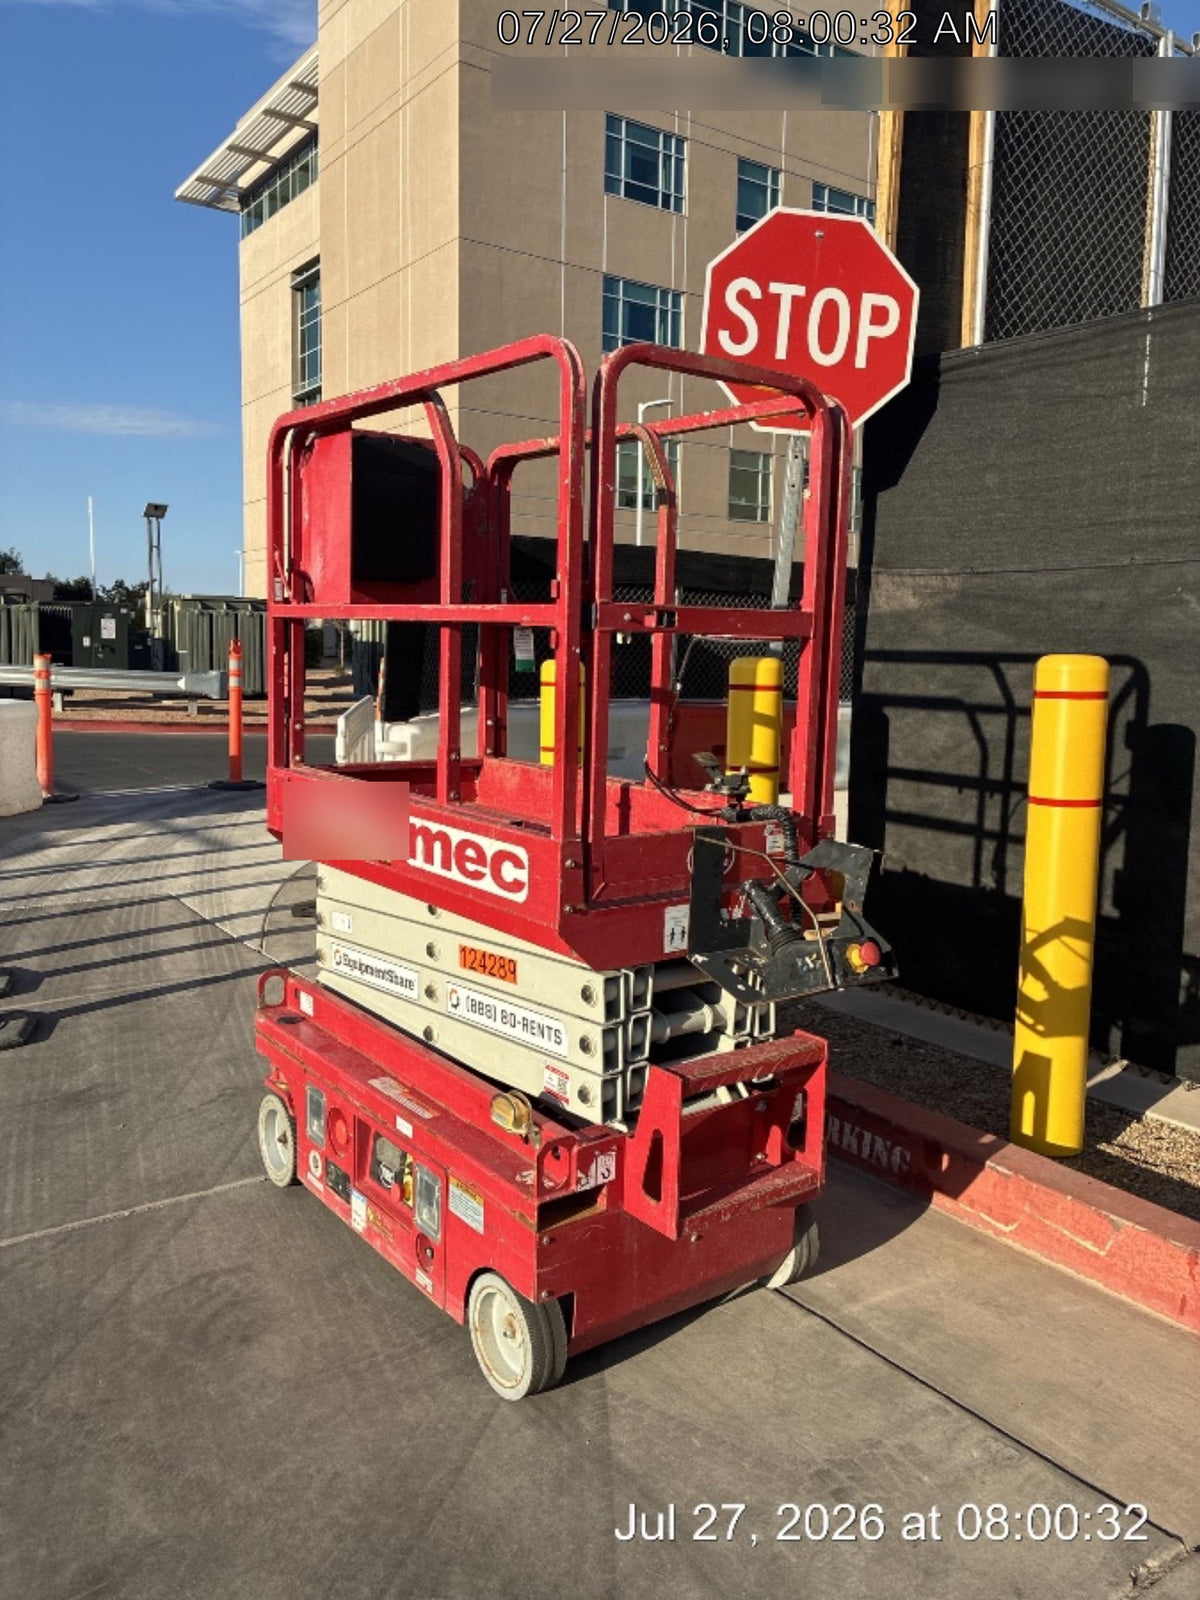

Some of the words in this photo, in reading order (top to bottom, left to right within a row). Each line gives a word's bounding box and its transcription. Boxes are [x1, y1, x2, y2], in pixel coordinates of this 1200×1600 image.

[718, 276, 900, 369] STOP
[409, 822, 526, 894] mec
[459, 945, 517, 984] 124289
[466, 995, 497, 1022] (888)
[501, 1009, 563, 1046] 80-RENTS
